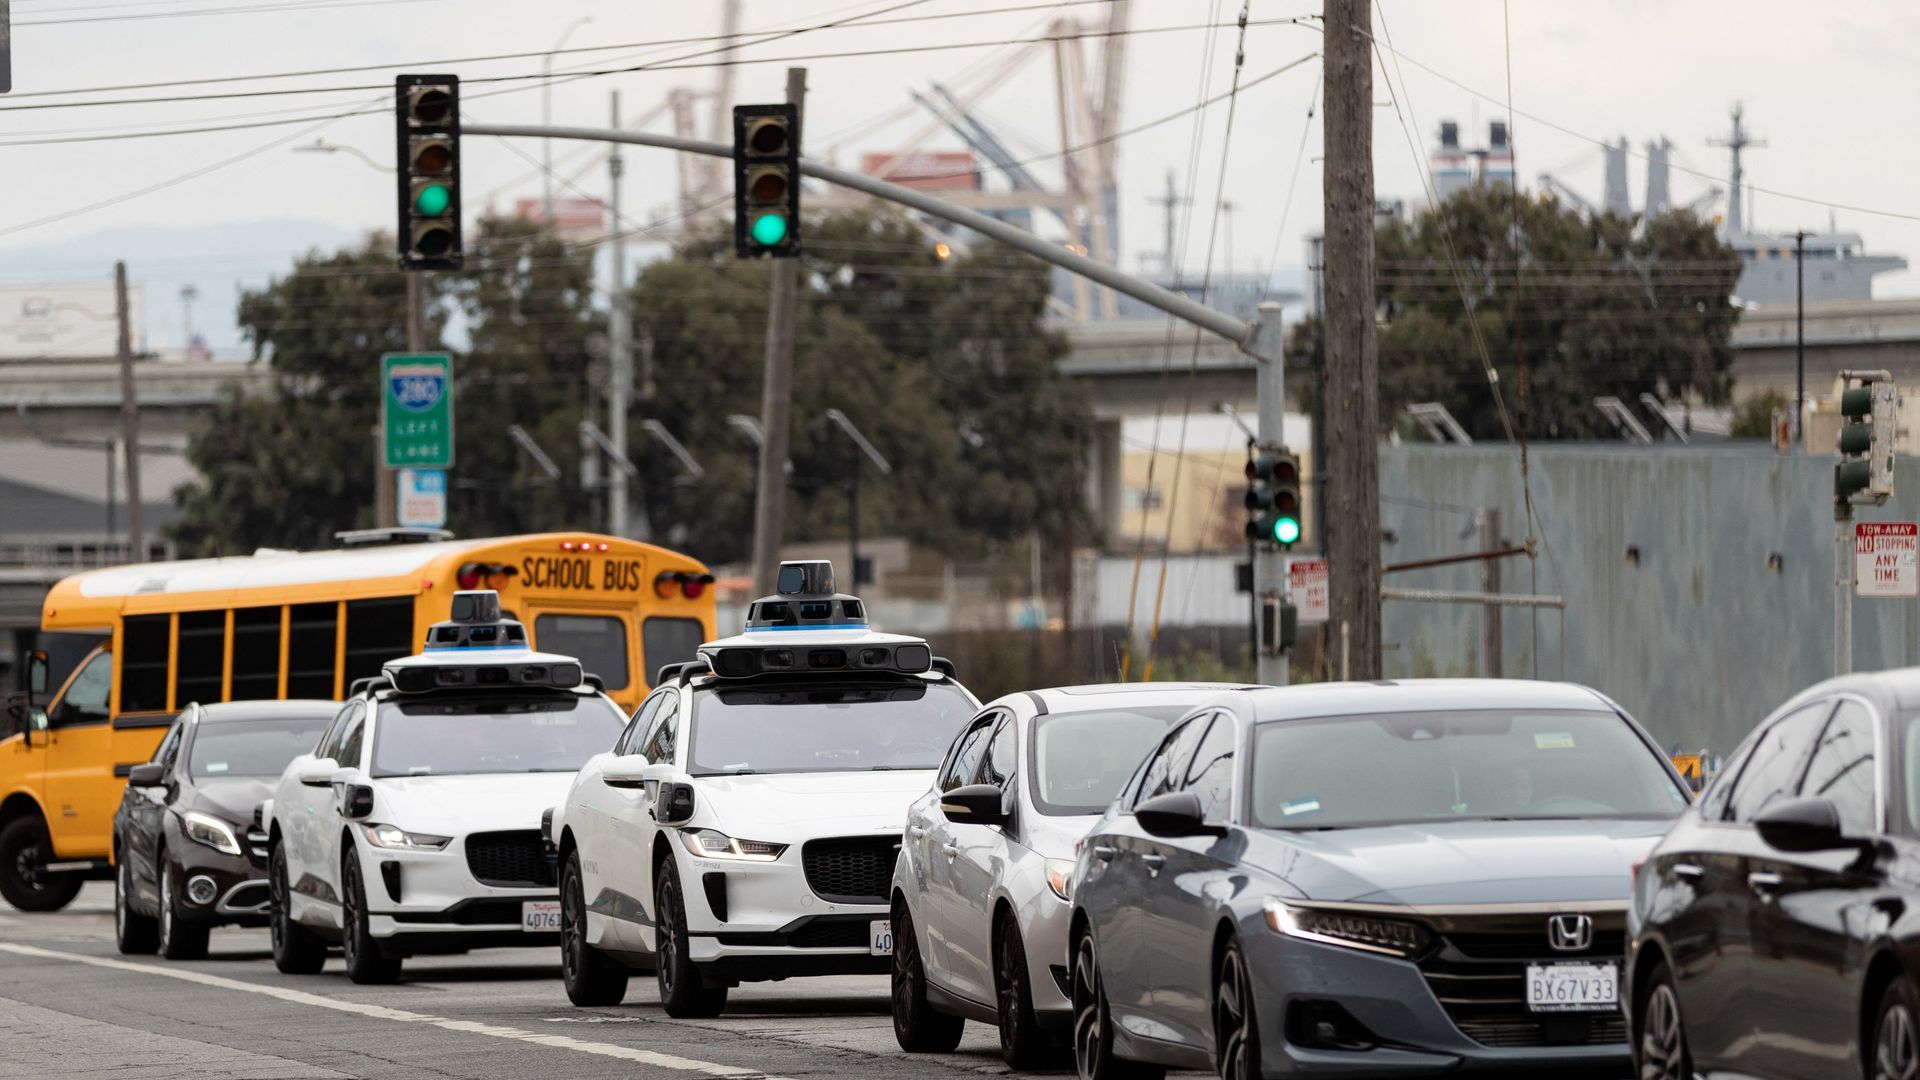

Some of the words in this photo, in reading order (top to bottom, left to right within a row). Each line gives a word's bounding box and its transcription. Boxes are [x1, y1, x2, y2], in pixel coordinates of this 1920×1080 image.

[400, 379, 438, 401] 280
[396, 421, 438, 436] LEFT
[395, 445, 440, 458] LANE
[1862, 524, 1911, 535] TOW-AWAY
[1857, 536, 1873, 552] NO
[1876, 538, 1915, 551] STOPPING
[1875, 555, 1898, 566] ANY
[522, 557, 595, 589] SCHOOL
[603, 560, 641, 591] BUS
[1875, 568, 1899, 581] TIME
[1533, 979, 1613, 1001] BX67V33
